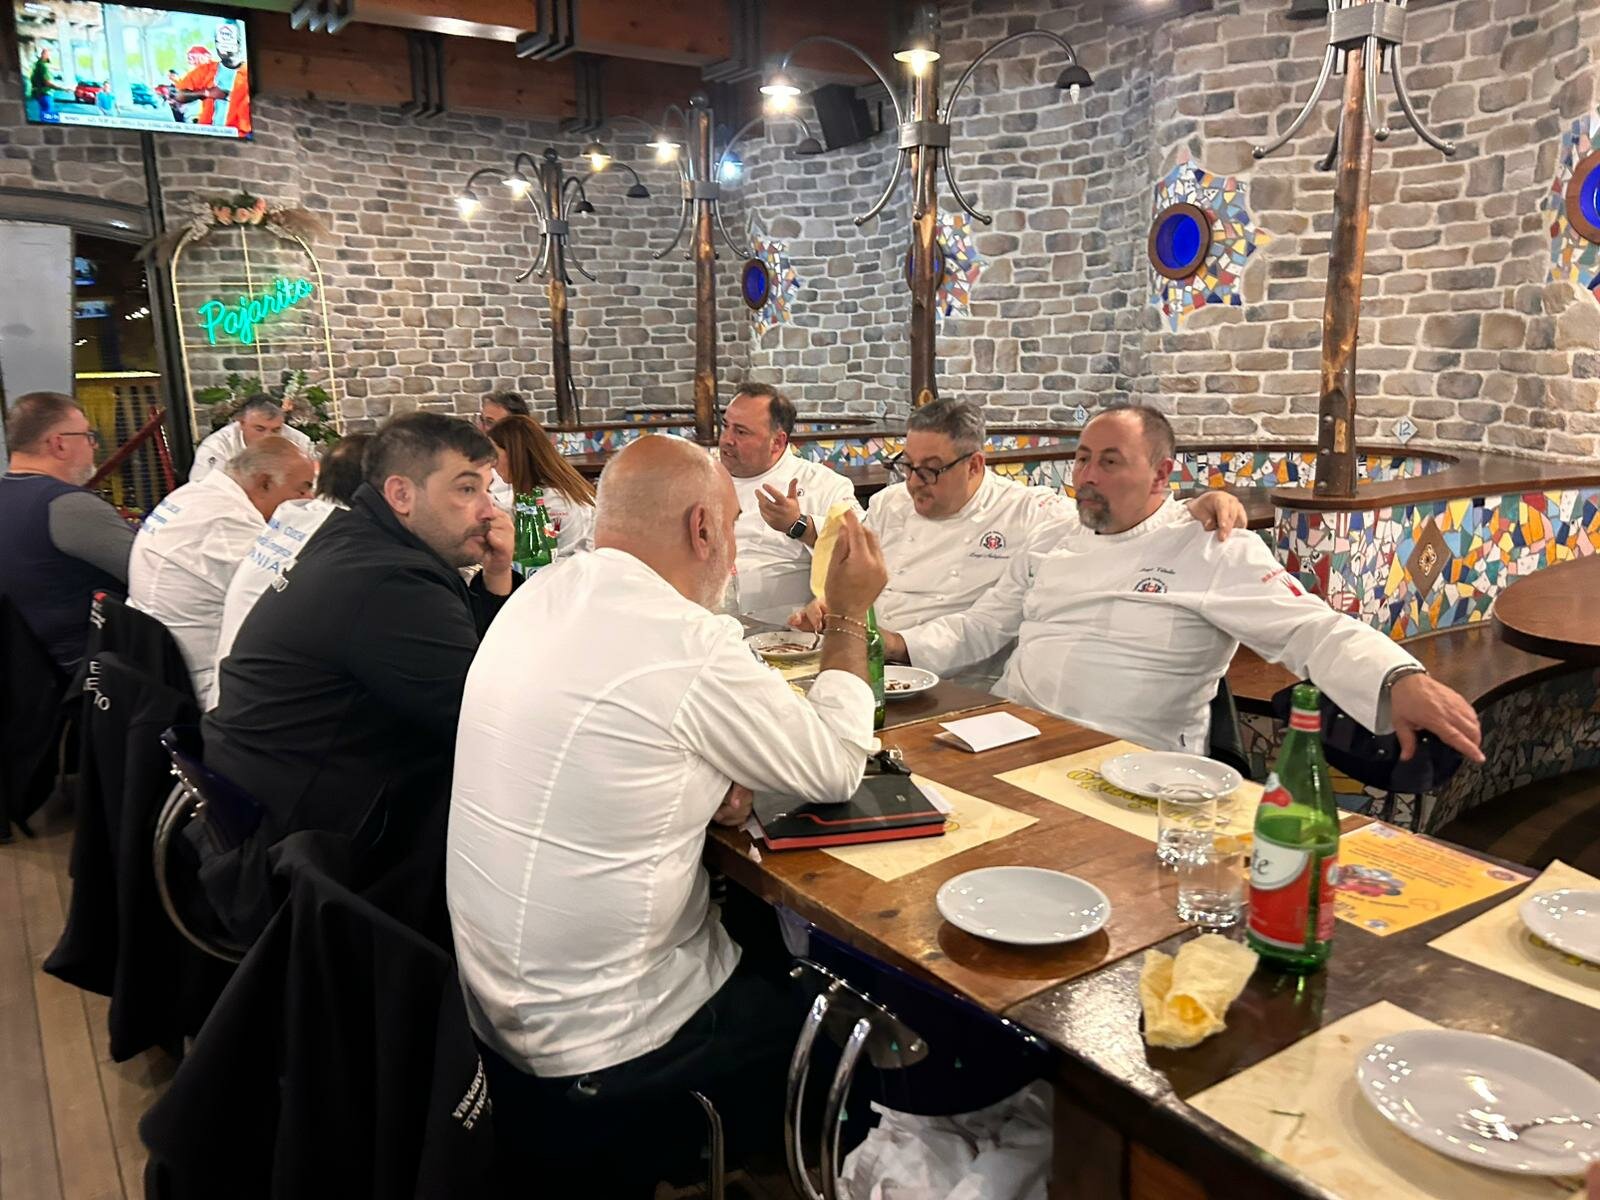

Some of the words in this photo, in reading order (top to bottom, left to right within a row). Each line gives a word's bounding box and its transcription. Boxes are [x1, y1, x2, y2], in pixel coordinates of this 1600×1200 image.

[198, 278, 313, 346] Pajarito
[1399, 421, 1411, 436] 12
[1253, 849, 1270, 875] te
